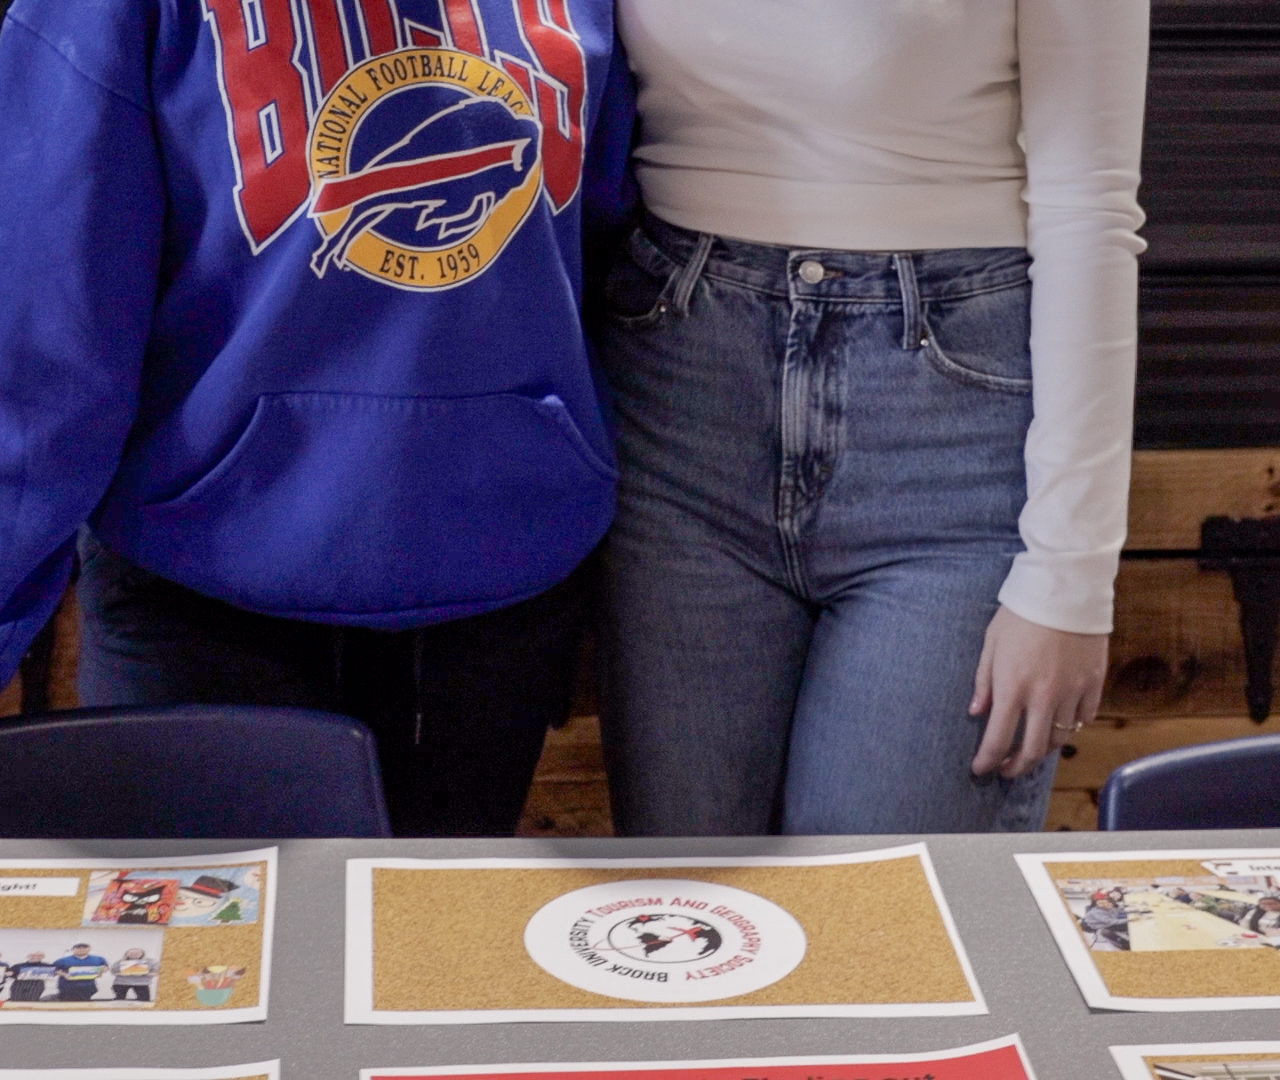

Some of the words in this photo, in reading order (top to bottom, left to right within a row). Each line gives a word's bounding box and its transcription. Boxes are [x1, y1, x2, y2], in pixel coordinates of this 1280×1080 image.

[366, 53, 469, 92] FOOTBALL
[380, 249, 425, 281] EST.
[436, 243, 481, 280] 1959
[585, 896, 664, 918] TOURISM
[669, 896, 710, 911] AND
[569, 916, 608, 968] UNIVERSITY
[709, 904, 763, 956] GEOGRAPHY
[606, 963, 669, 983] BROCK
[684, 953, 755, 982] SOCIETY
